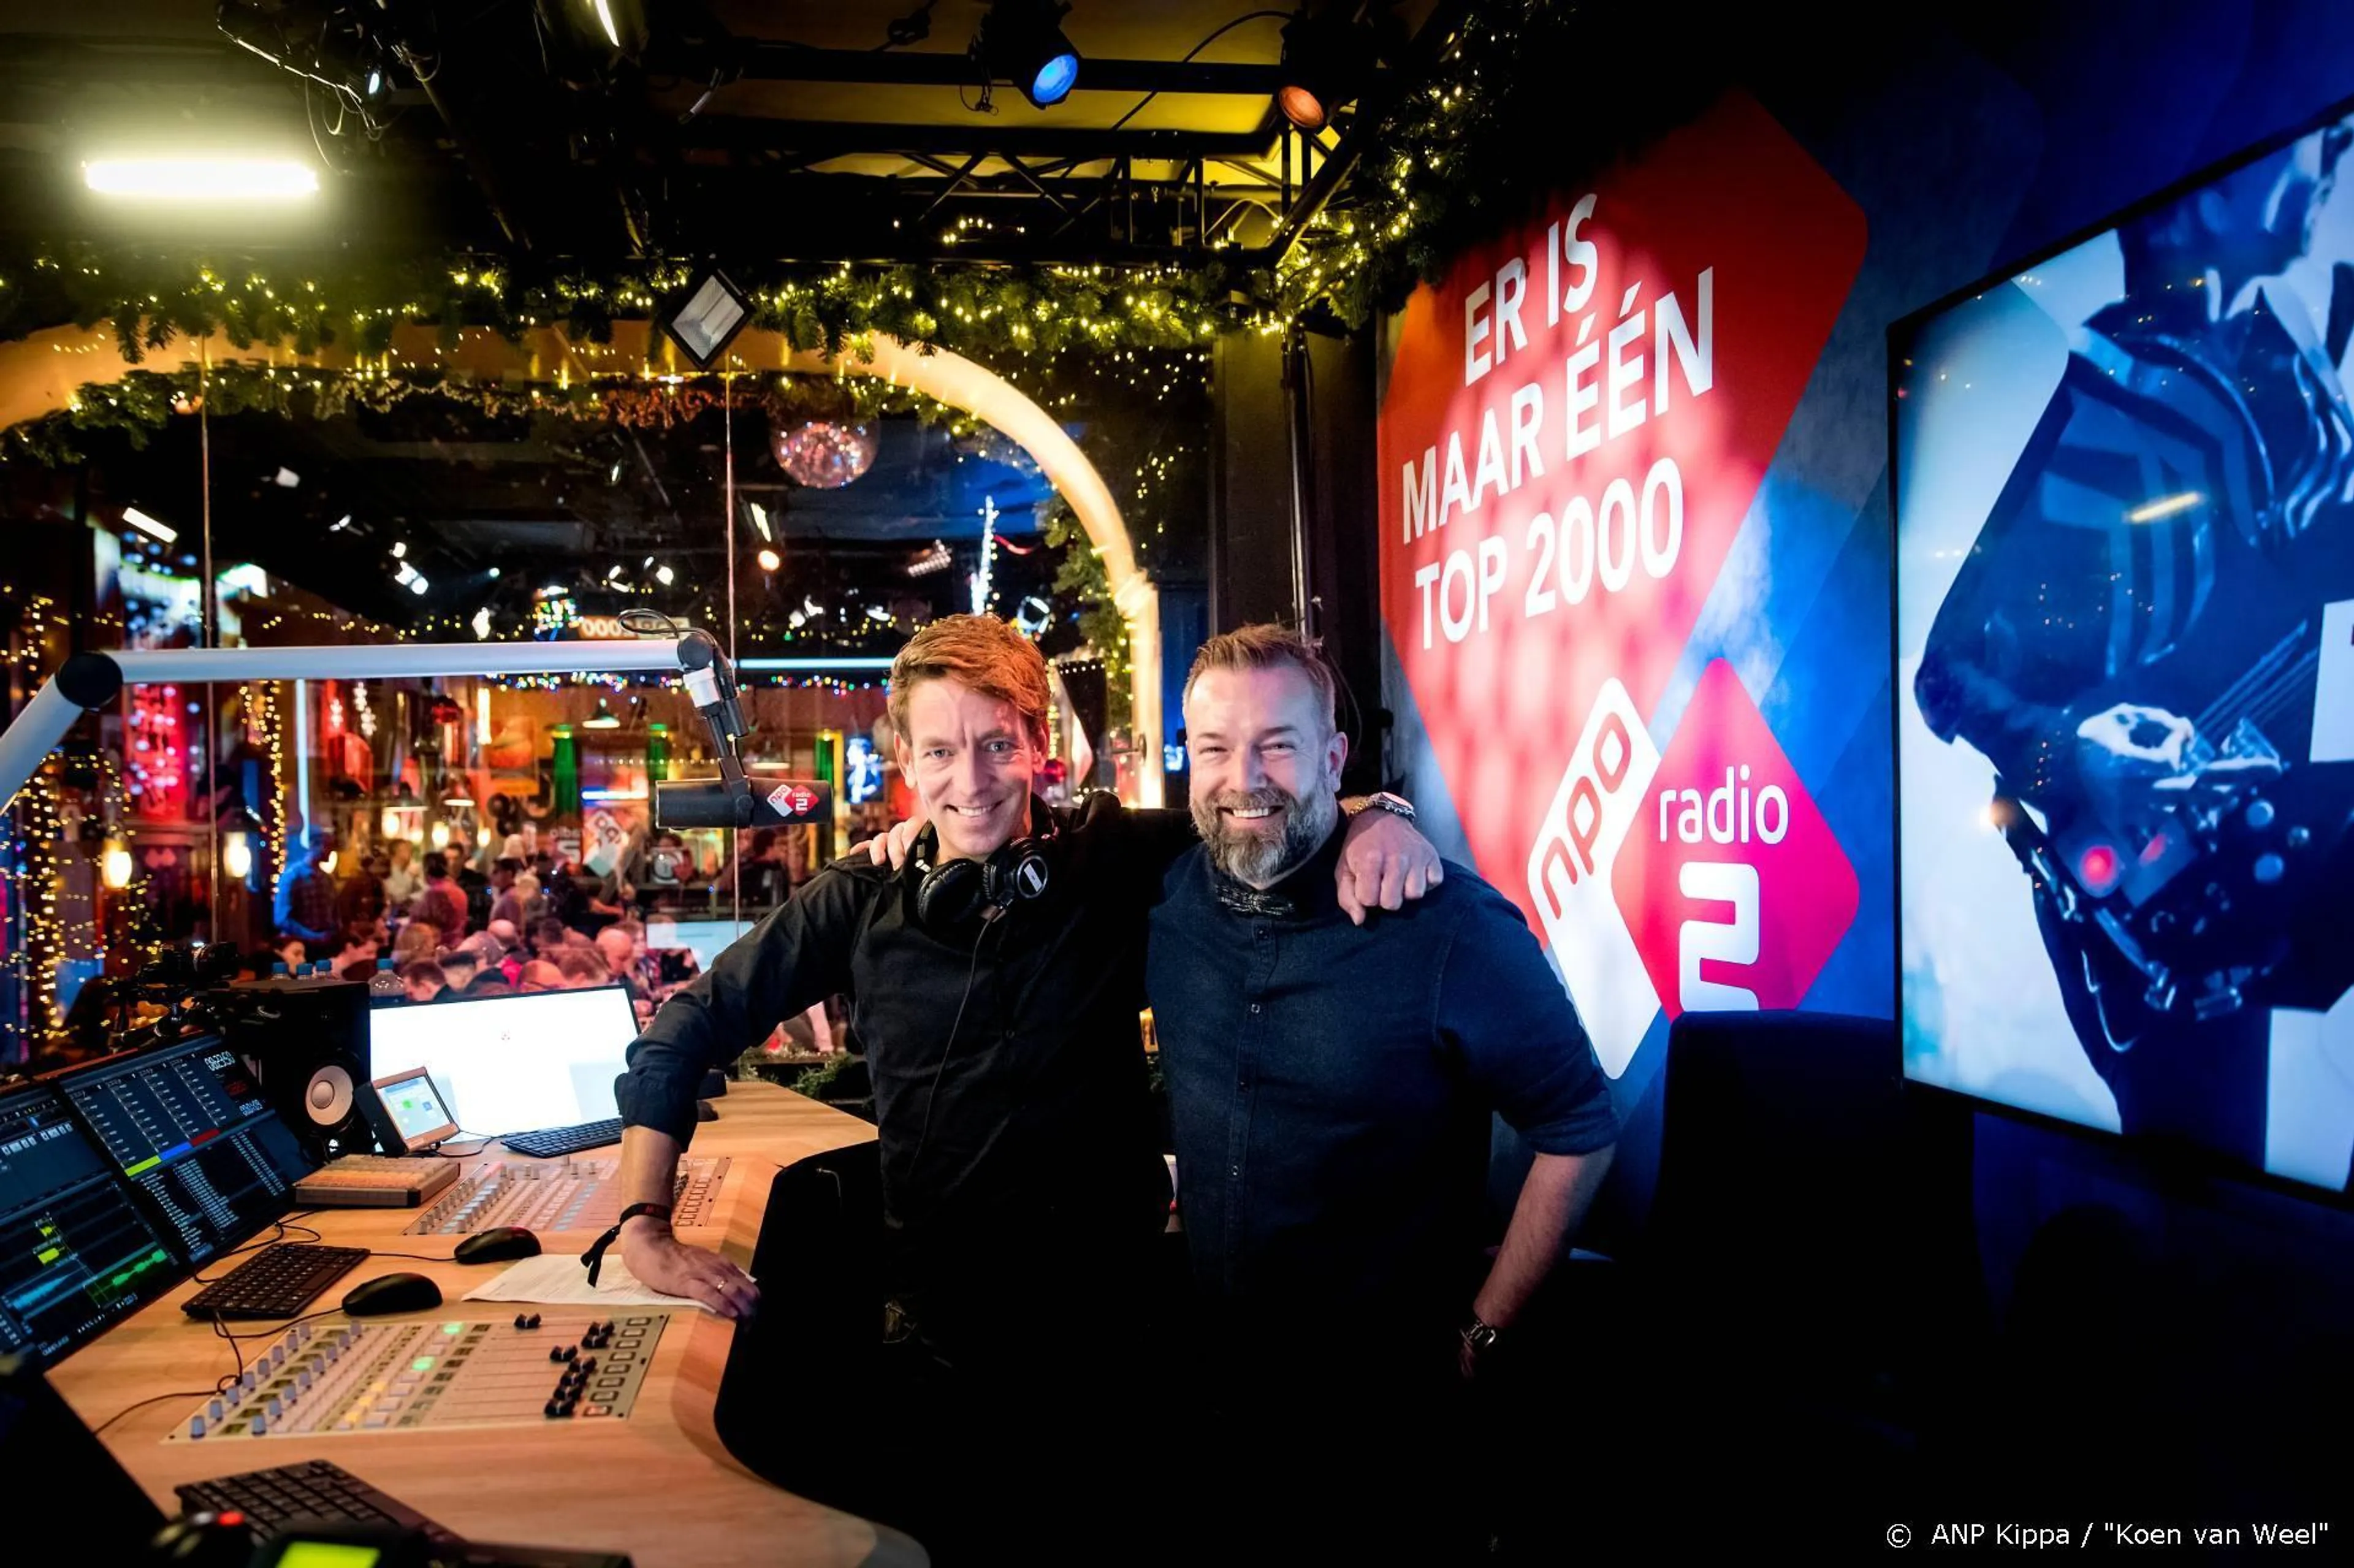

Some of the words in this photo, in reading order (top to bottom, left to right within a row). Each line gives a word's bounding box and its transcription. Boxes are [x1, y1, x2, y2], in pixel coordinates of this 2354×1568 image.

[1465, 257, 1527, 387] ER
[1548, 193, 1598, 327] IS
[1403, 382, 1544, 544] MAAR
[1566, 266, 1713, 462] ÉÉN
[1415, 536, 1507, 650] TOP
[1525, 457, 1683, 618] 2000
[770, 786, 788, 804] npo
[796, 798, 808, 811] 2
[1540, 712, 1631, 920] npo
[1659, 764, 1789, 844] radio
[1679, 861, 1759, 1011] 2
